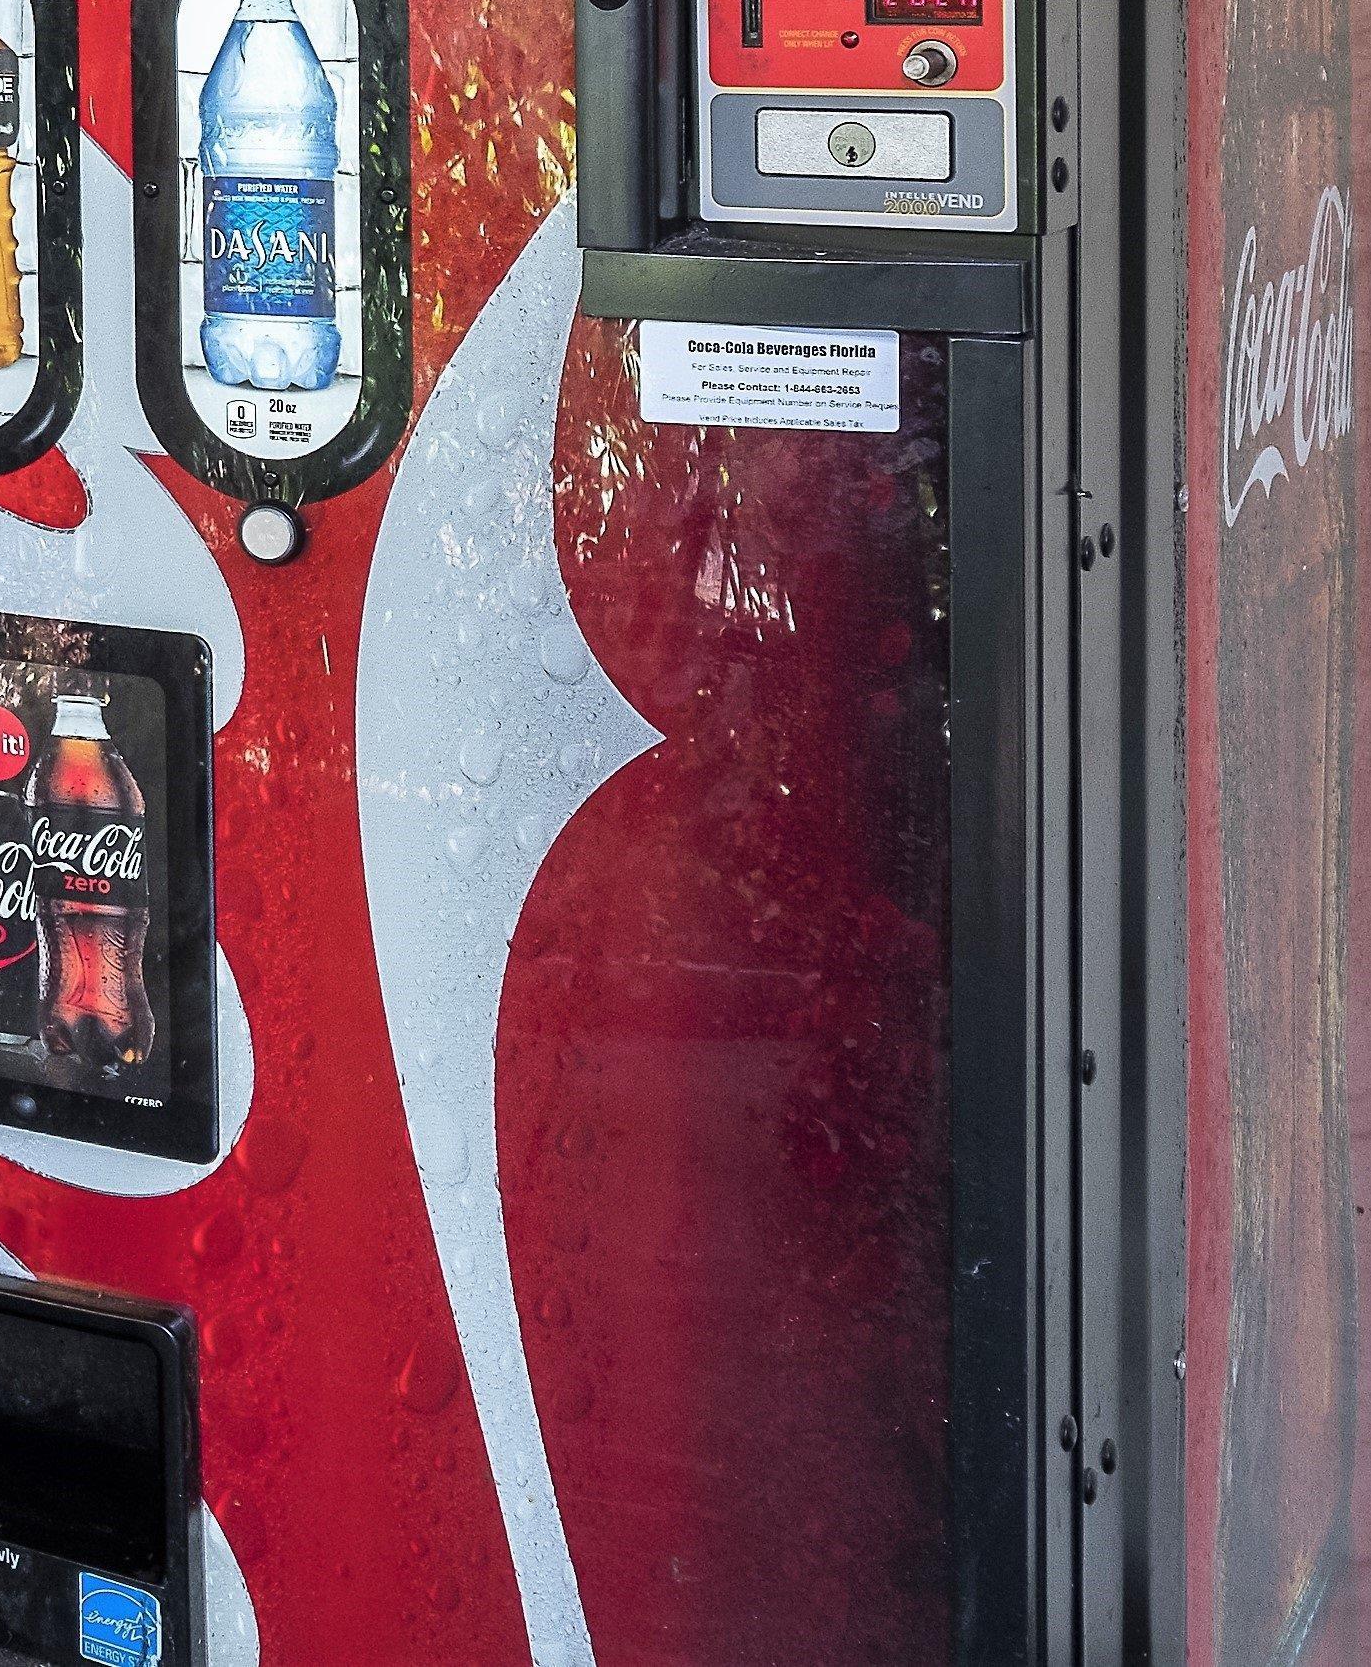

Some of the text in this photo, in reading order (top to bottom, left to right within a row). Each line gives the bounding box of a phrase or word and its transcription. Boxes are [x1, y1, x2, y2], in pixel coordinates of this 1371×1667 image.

[238, 183, 298, 193] PURIFIED WATER
[884, 200, 941, 215] 2000
[211, 220, 327, 270] DASANI
[688, 341, 875, 358] Coca-Cola Beverages Florida
[238, 399, 296, 419] 0 20 oz
[1, 734, 24, 756] it!
[33, 817, 143, 881] Coca-Cola
[65, 874, 111, 894] zero
[84, 1610, 132, 1639] energy
